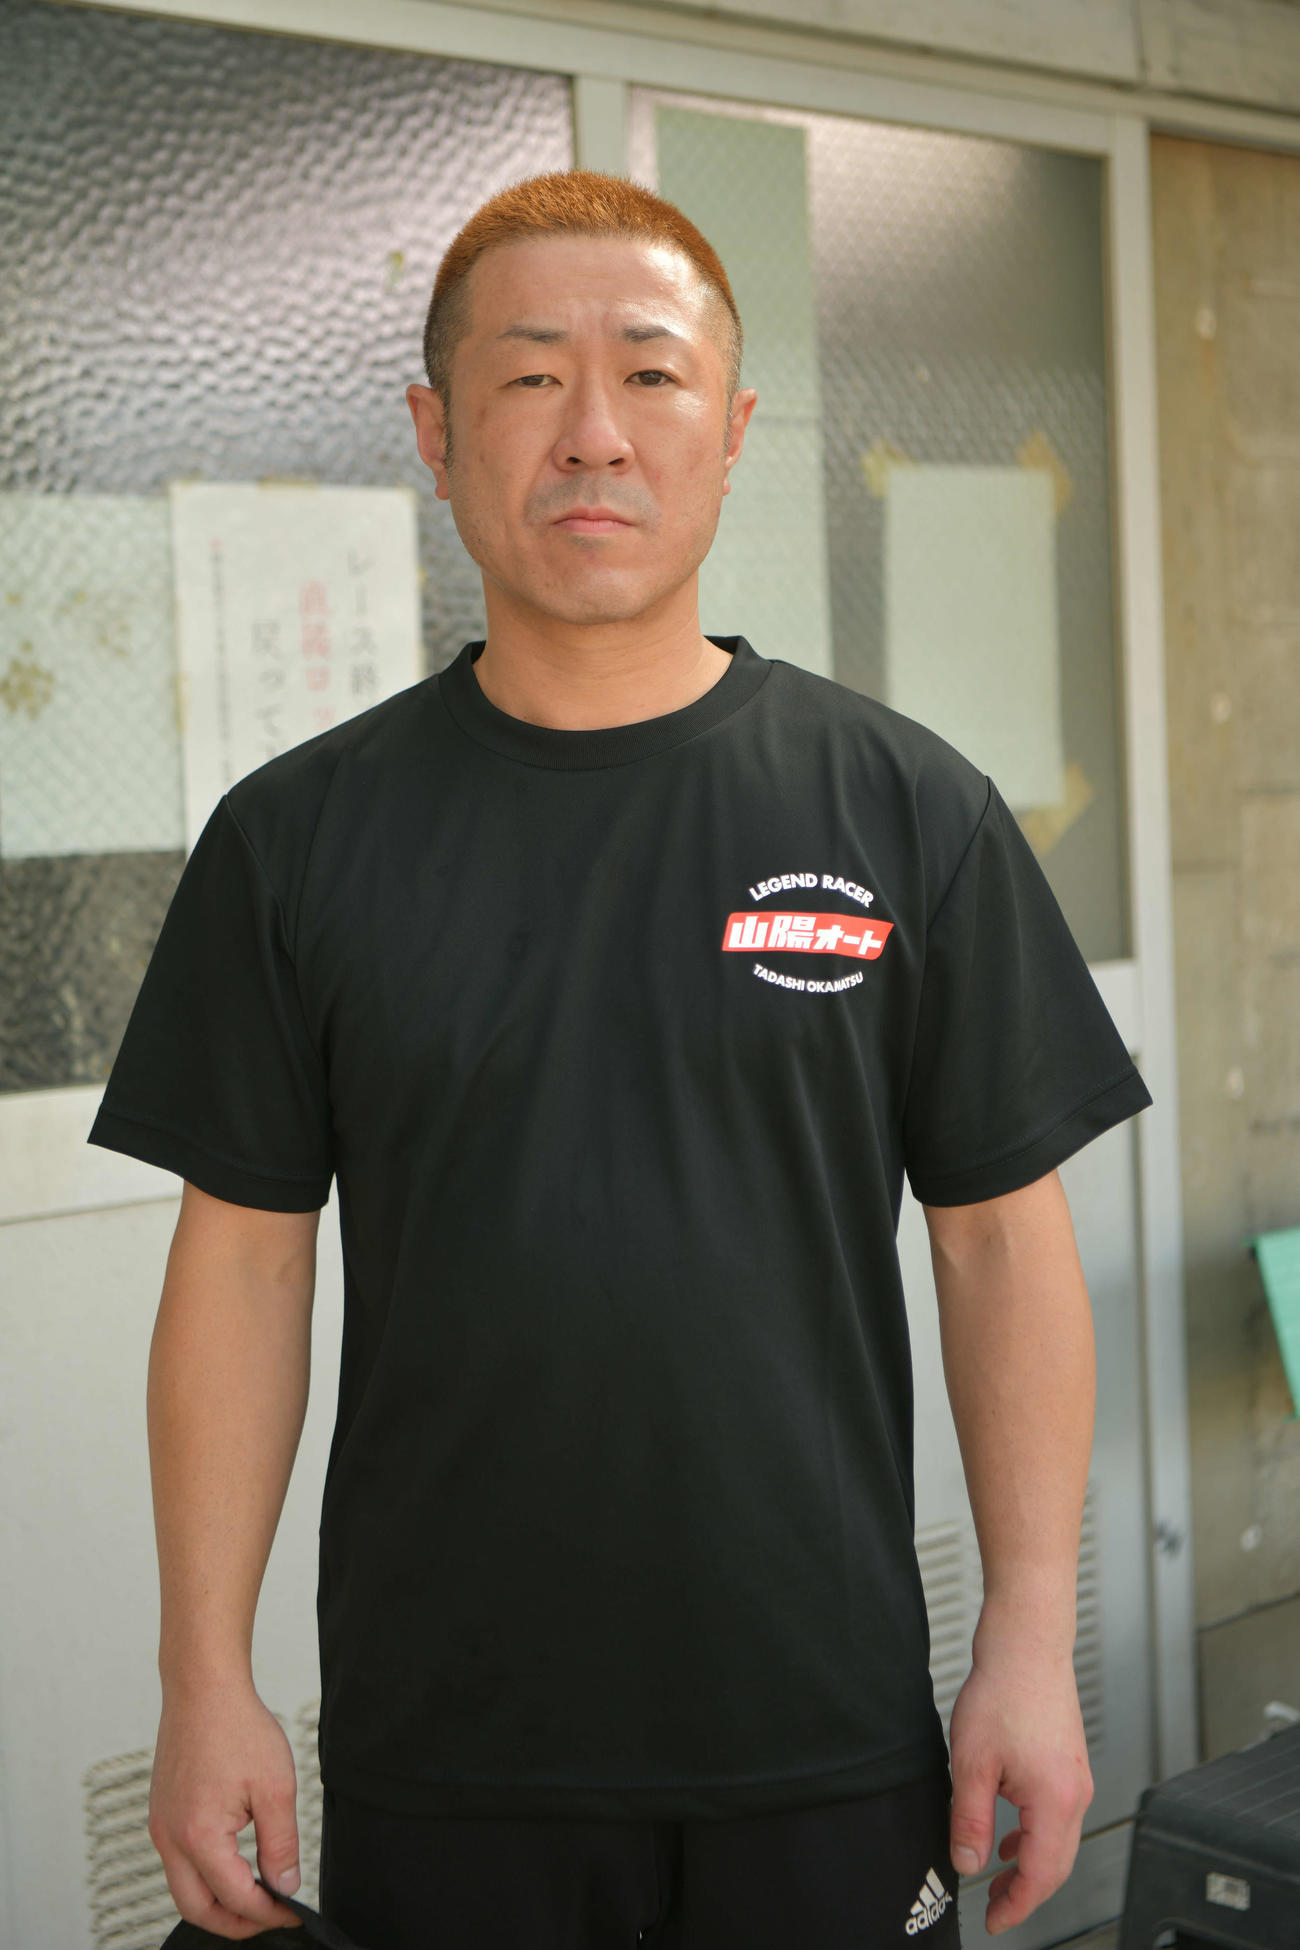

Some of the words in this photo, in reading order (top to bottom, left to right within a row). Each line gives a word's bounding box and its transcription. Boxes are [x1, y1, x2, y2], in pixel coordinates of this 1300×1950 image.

[749, 873, 818, 901] LEGEND
[822, 874, 873, 908] RACER
[728, 916, 882, 955] 山陽オート
[753, 963, 805, 991] TADASHI
